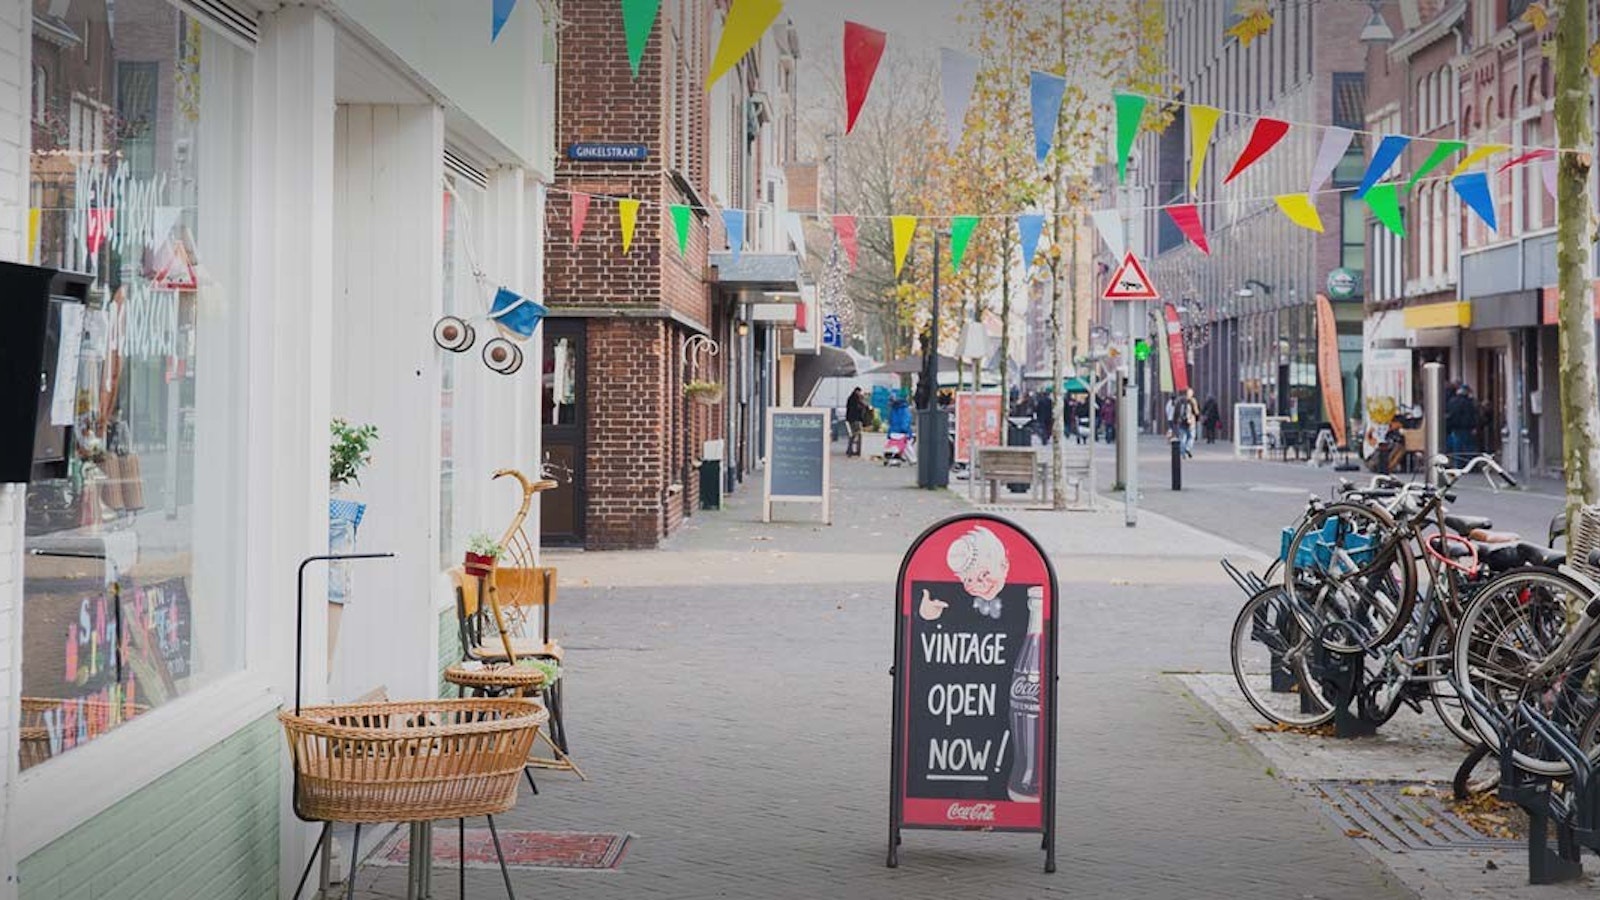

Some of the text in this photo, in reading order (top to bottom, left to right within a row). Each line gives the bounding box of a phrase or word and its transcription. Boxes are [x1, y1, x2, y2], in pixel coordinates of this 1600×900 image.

[576, 146, 638, 157] GINKELSTRAAT
[1010, 676, 1040, 702] Coca
[947, 802, 996, 821] Coca-Cola
